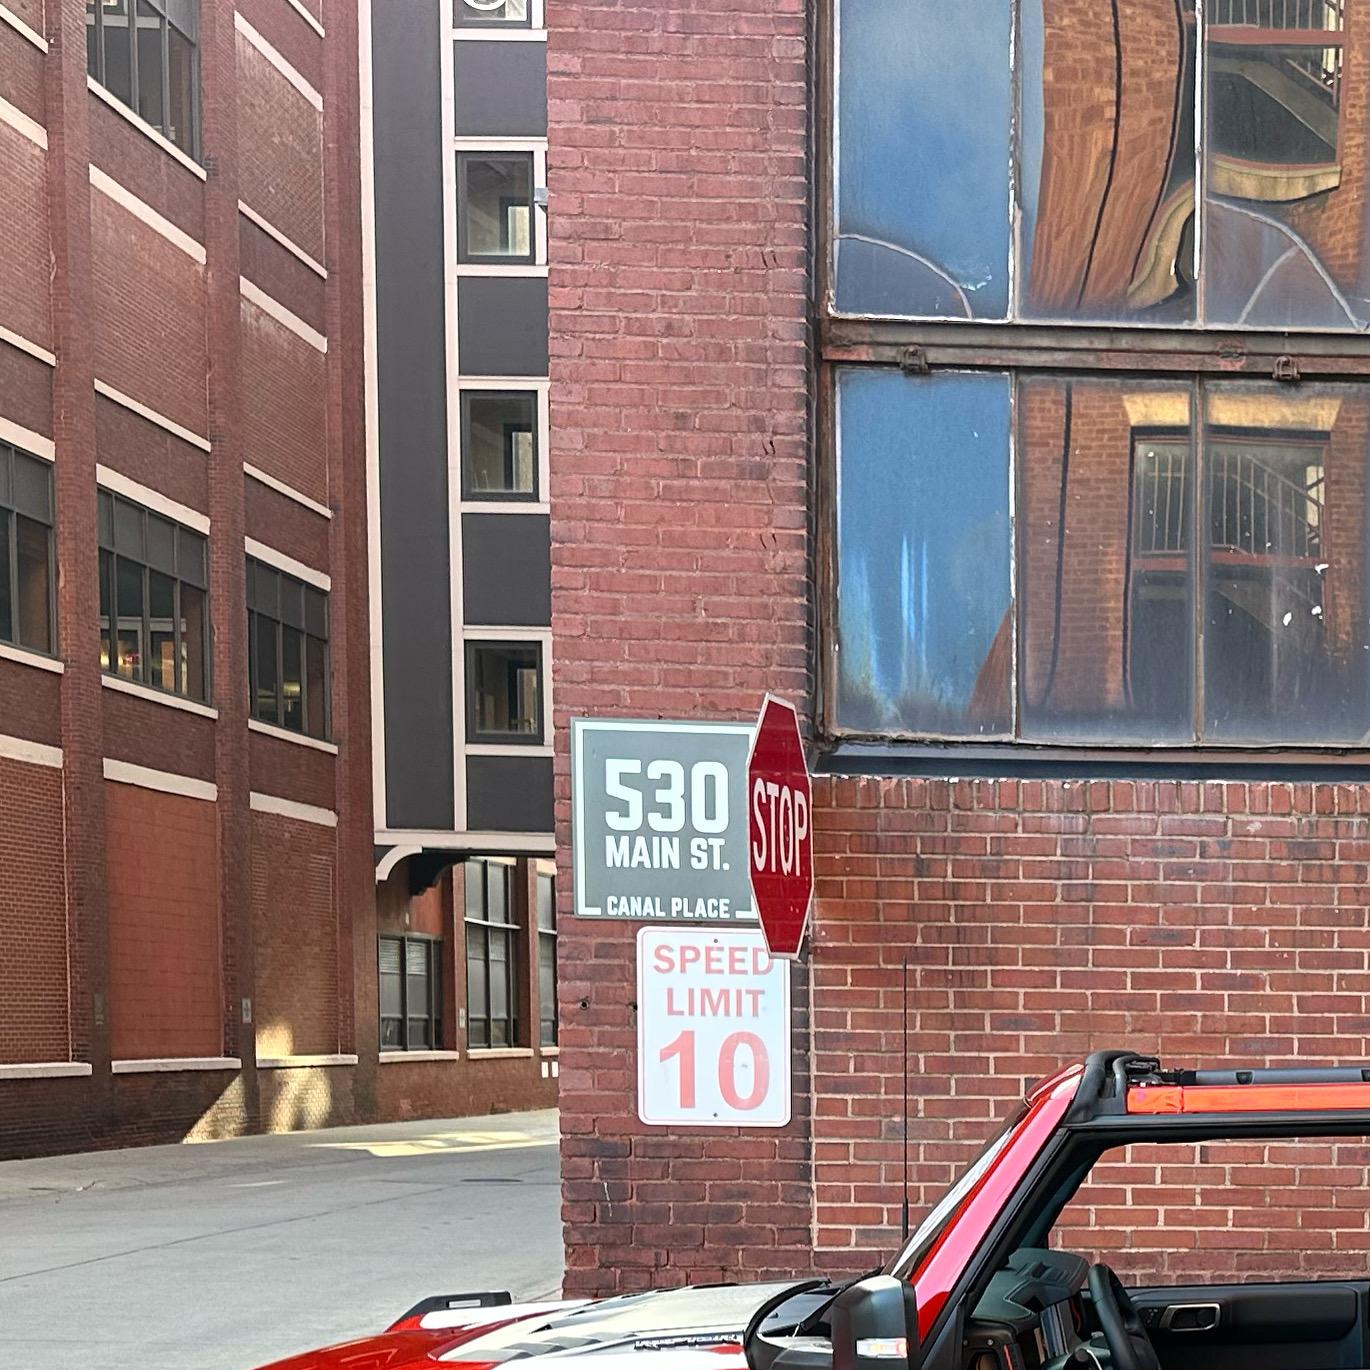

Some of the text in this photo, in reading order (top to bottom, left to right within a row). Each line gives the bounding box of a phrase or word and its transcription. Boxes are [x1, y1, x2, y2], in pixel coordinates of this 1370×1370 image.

[605, 758, 729, 834] 530
[753, 777, 808, 877] STOP
[605, 835, 730, 871] MAIN ST.
[607, 896, 730, 919] CANAL PLACE
[653, 944, 774, 975] SPEED
[667, 988, 766, 1018] LIMIT
[659, 1029, 770, 1111] 10
